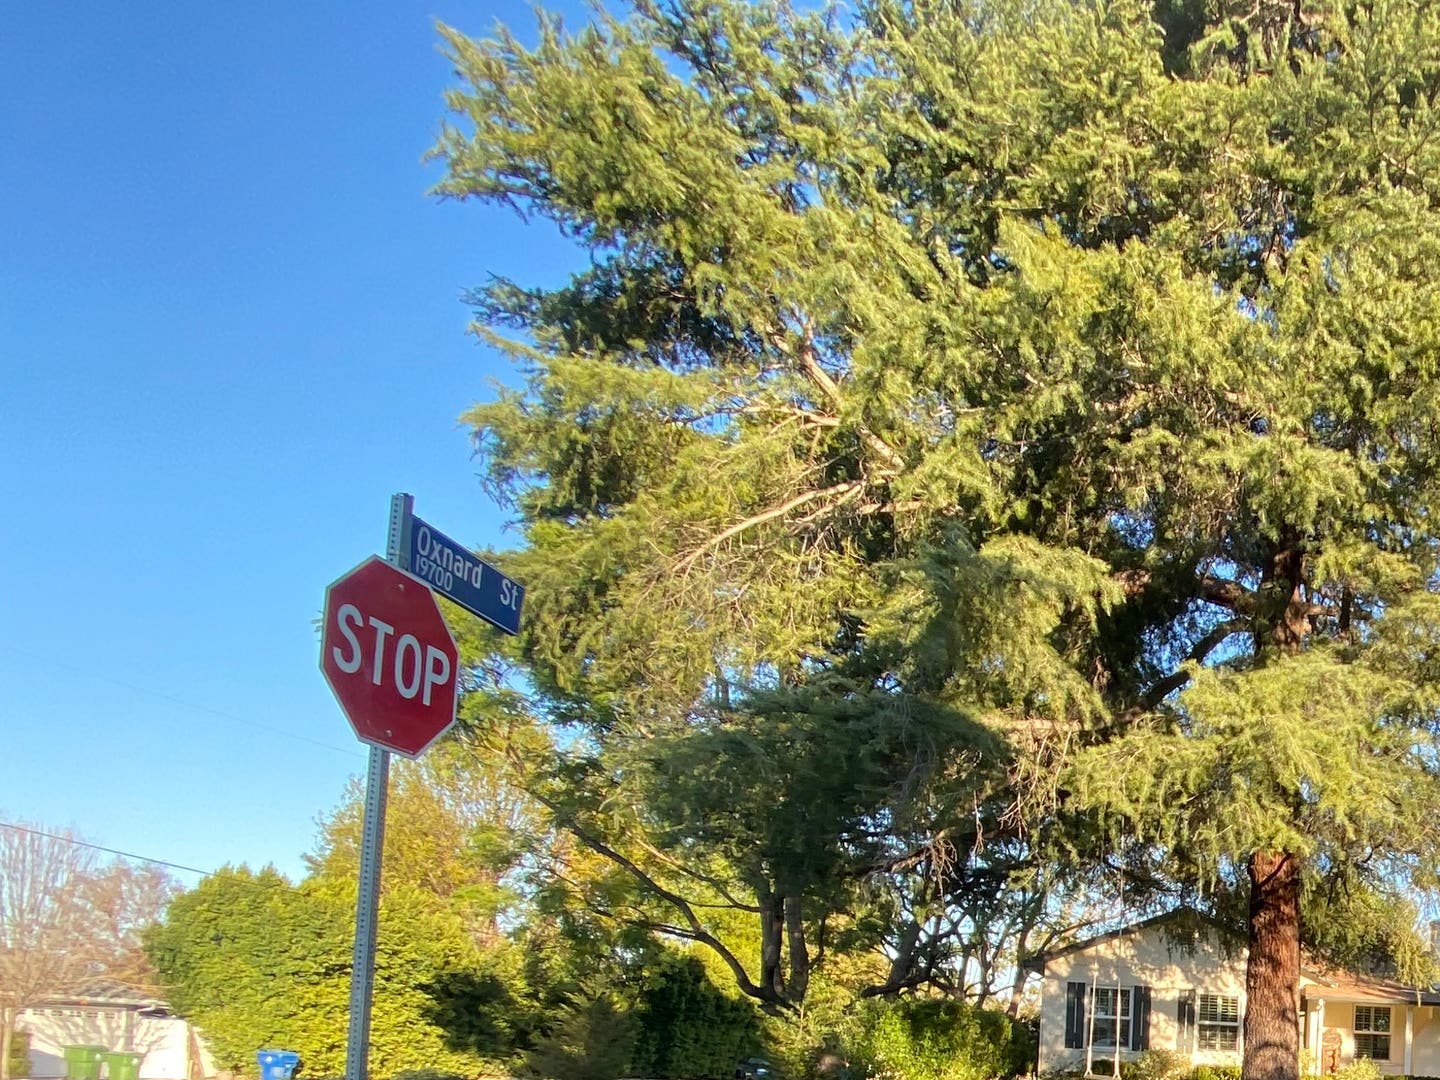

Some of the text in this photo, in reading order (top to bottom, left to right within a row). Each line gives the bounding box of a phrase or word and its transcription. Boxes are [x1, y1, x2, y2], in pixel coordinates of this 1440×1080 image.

[415, 554, 454, 592] 19700
[417, 526, 518, 611] Oxnard St
[332, 603, 451, 707] STOP
